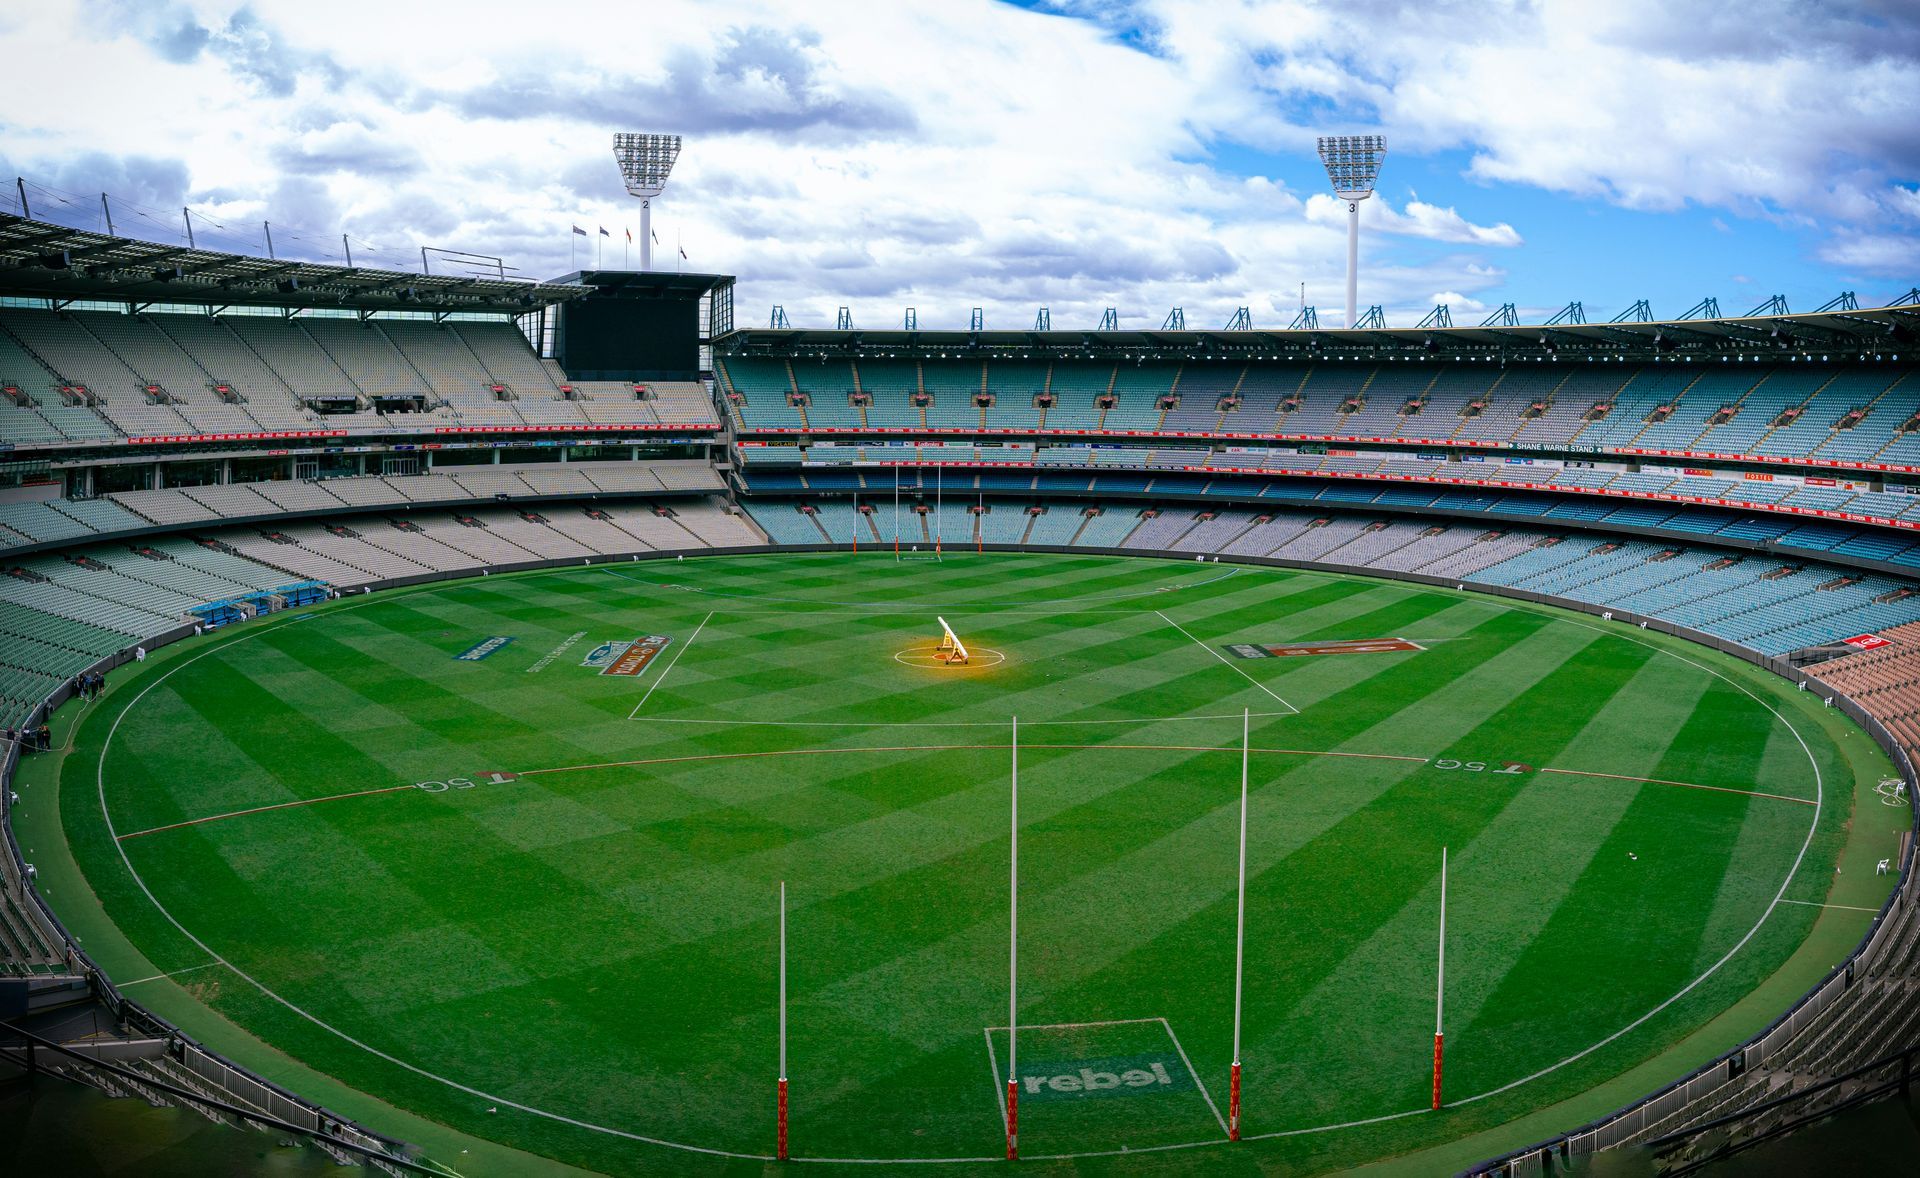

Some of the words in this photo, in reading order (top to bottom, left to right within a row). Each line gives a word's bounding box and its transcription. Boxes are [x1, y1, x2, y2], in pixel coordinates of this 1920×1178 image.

[1349, 204, 1355, 212] 3
[1434, 759, 1487, 772] 5G
[416, 777, 476, 793] 5G
[1023, 1062, 1172, 1094] rebel
